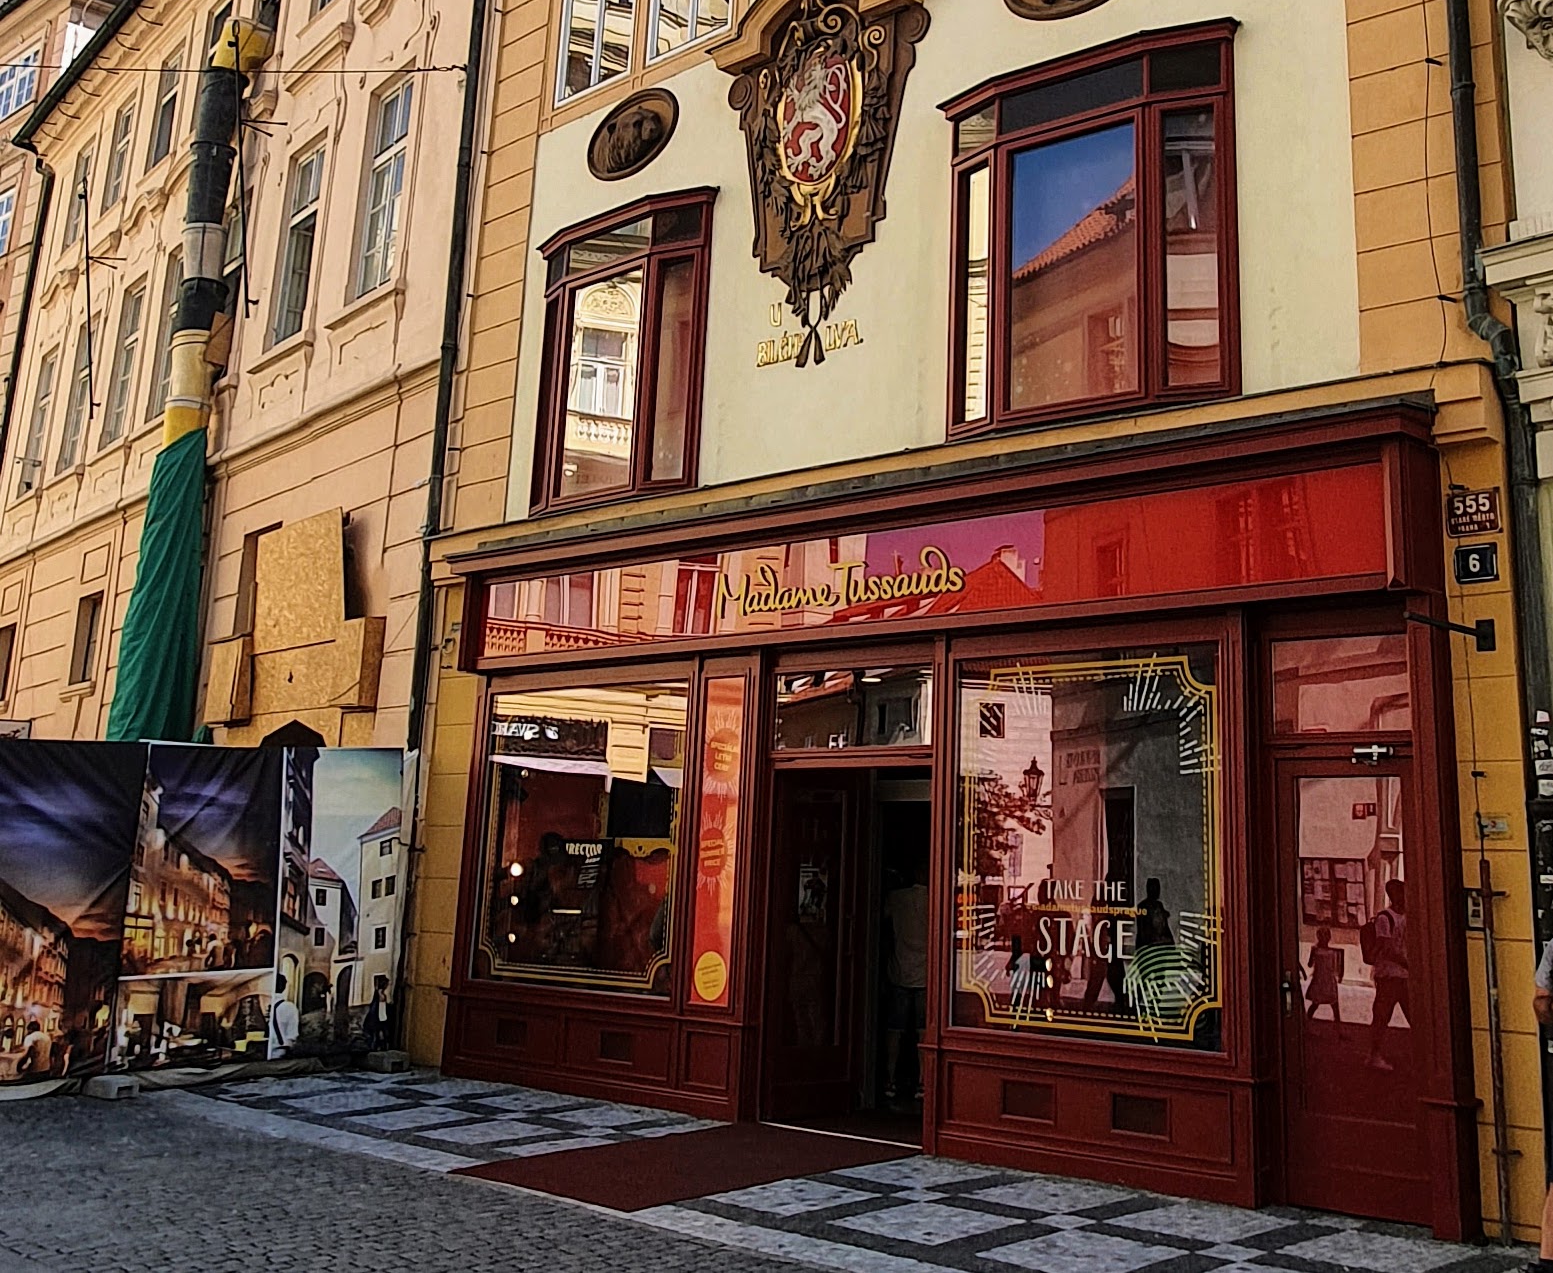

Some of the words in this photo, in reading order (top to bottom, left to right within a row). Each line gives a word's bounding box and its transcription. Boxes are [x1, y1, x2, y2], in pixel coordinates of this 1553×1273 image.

[769, 302, 782, 328] U
[1453, 493, 1490, 515] 555
[1468, 553, 1481, 573] 6
[717, 562, 838, 619] Madame
[827, 545, 967, 606] Tussauds
[1045, 879, 1085, 900] TAKE
[1093, 880, 1128, 902] THE
[1036, 916, 1135, 964] STAGE
